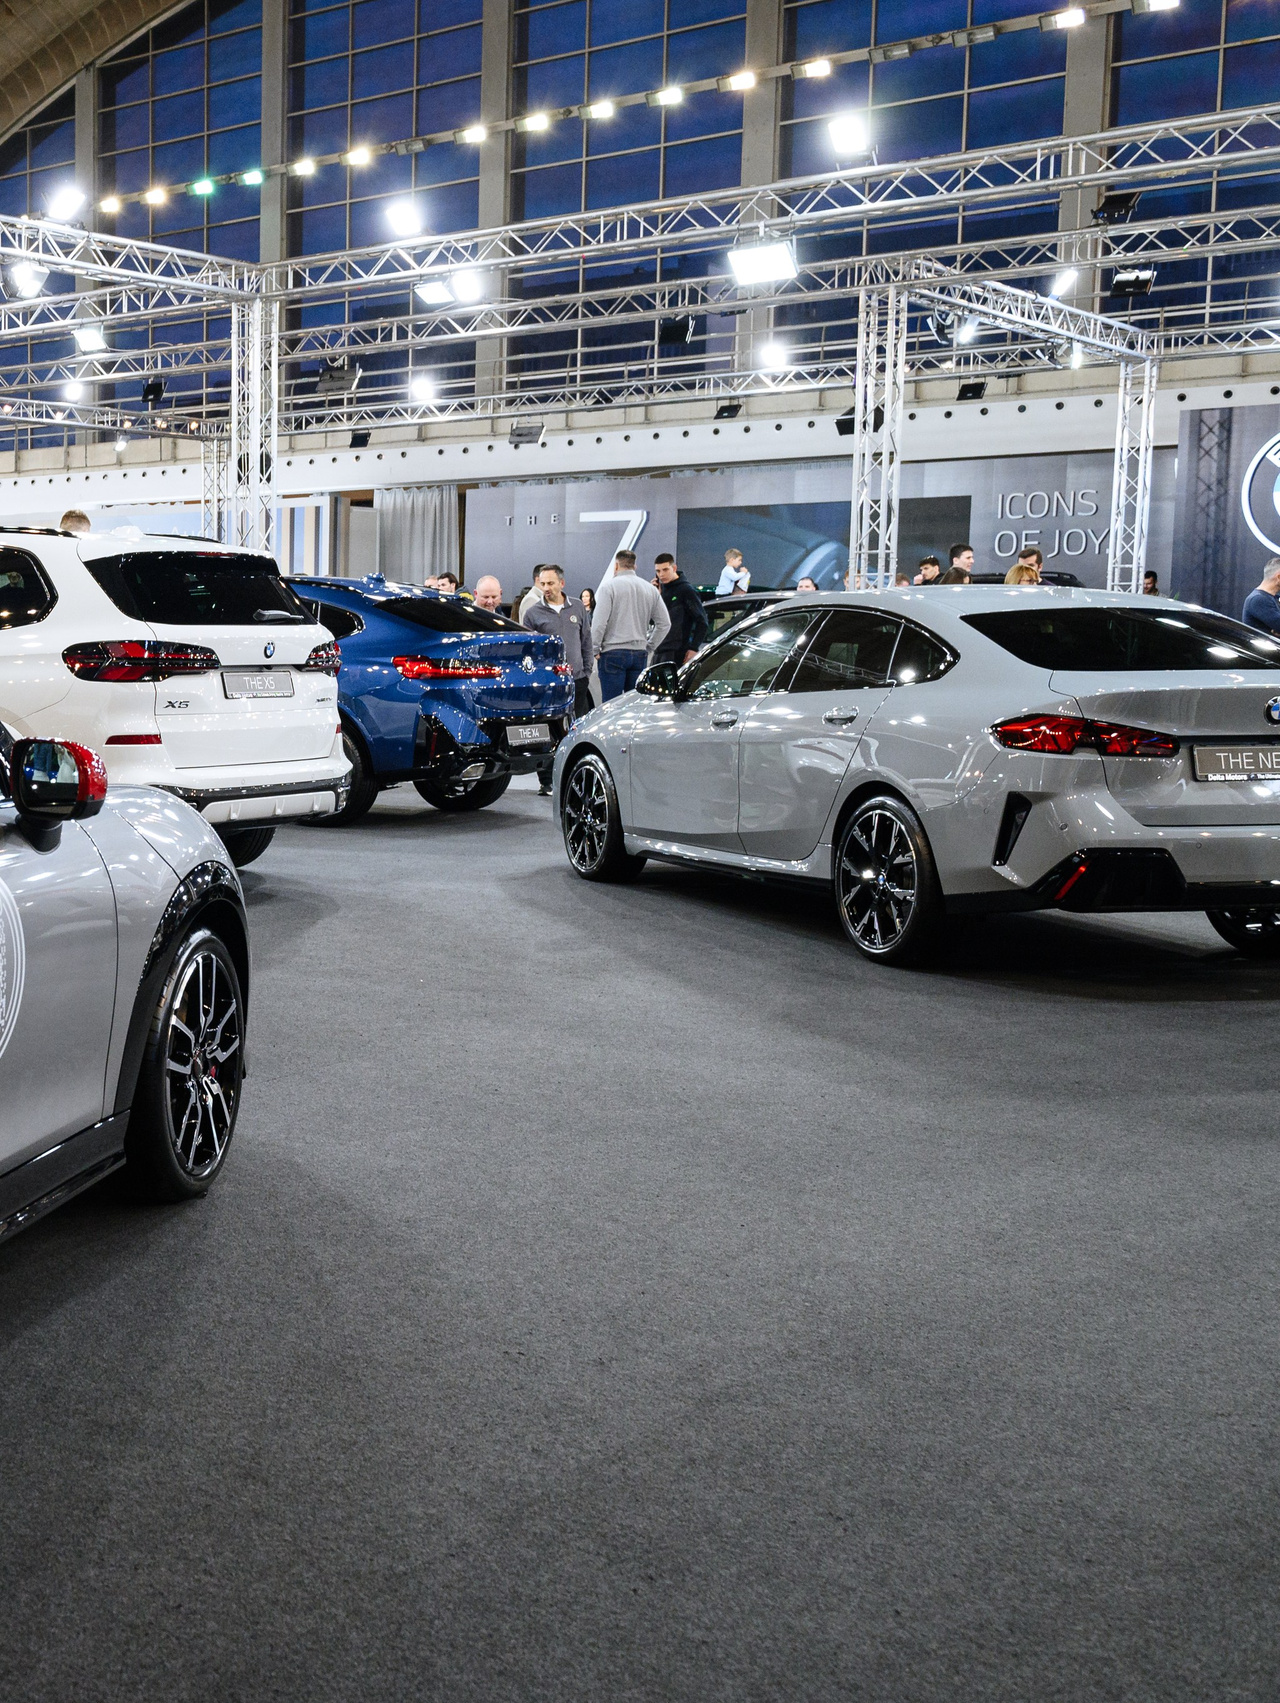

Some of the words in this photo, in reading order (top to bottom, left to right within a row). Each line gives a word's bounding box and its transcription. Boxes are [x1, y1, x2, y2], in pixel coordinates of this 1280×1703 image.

[997, 489, 1099, 519] ICONS
[994, 529, 1042, 557] OF
[505, 513, 561, 526] THE
[579, 510, 650, 604] 7
[243, 677, 264, 690] THE
[264, 677, 276, 690] X5
[163, 700, 190, 709] X5
[519, 728, 532, 739] THE
[1216, 752, 1255, 770] THE
